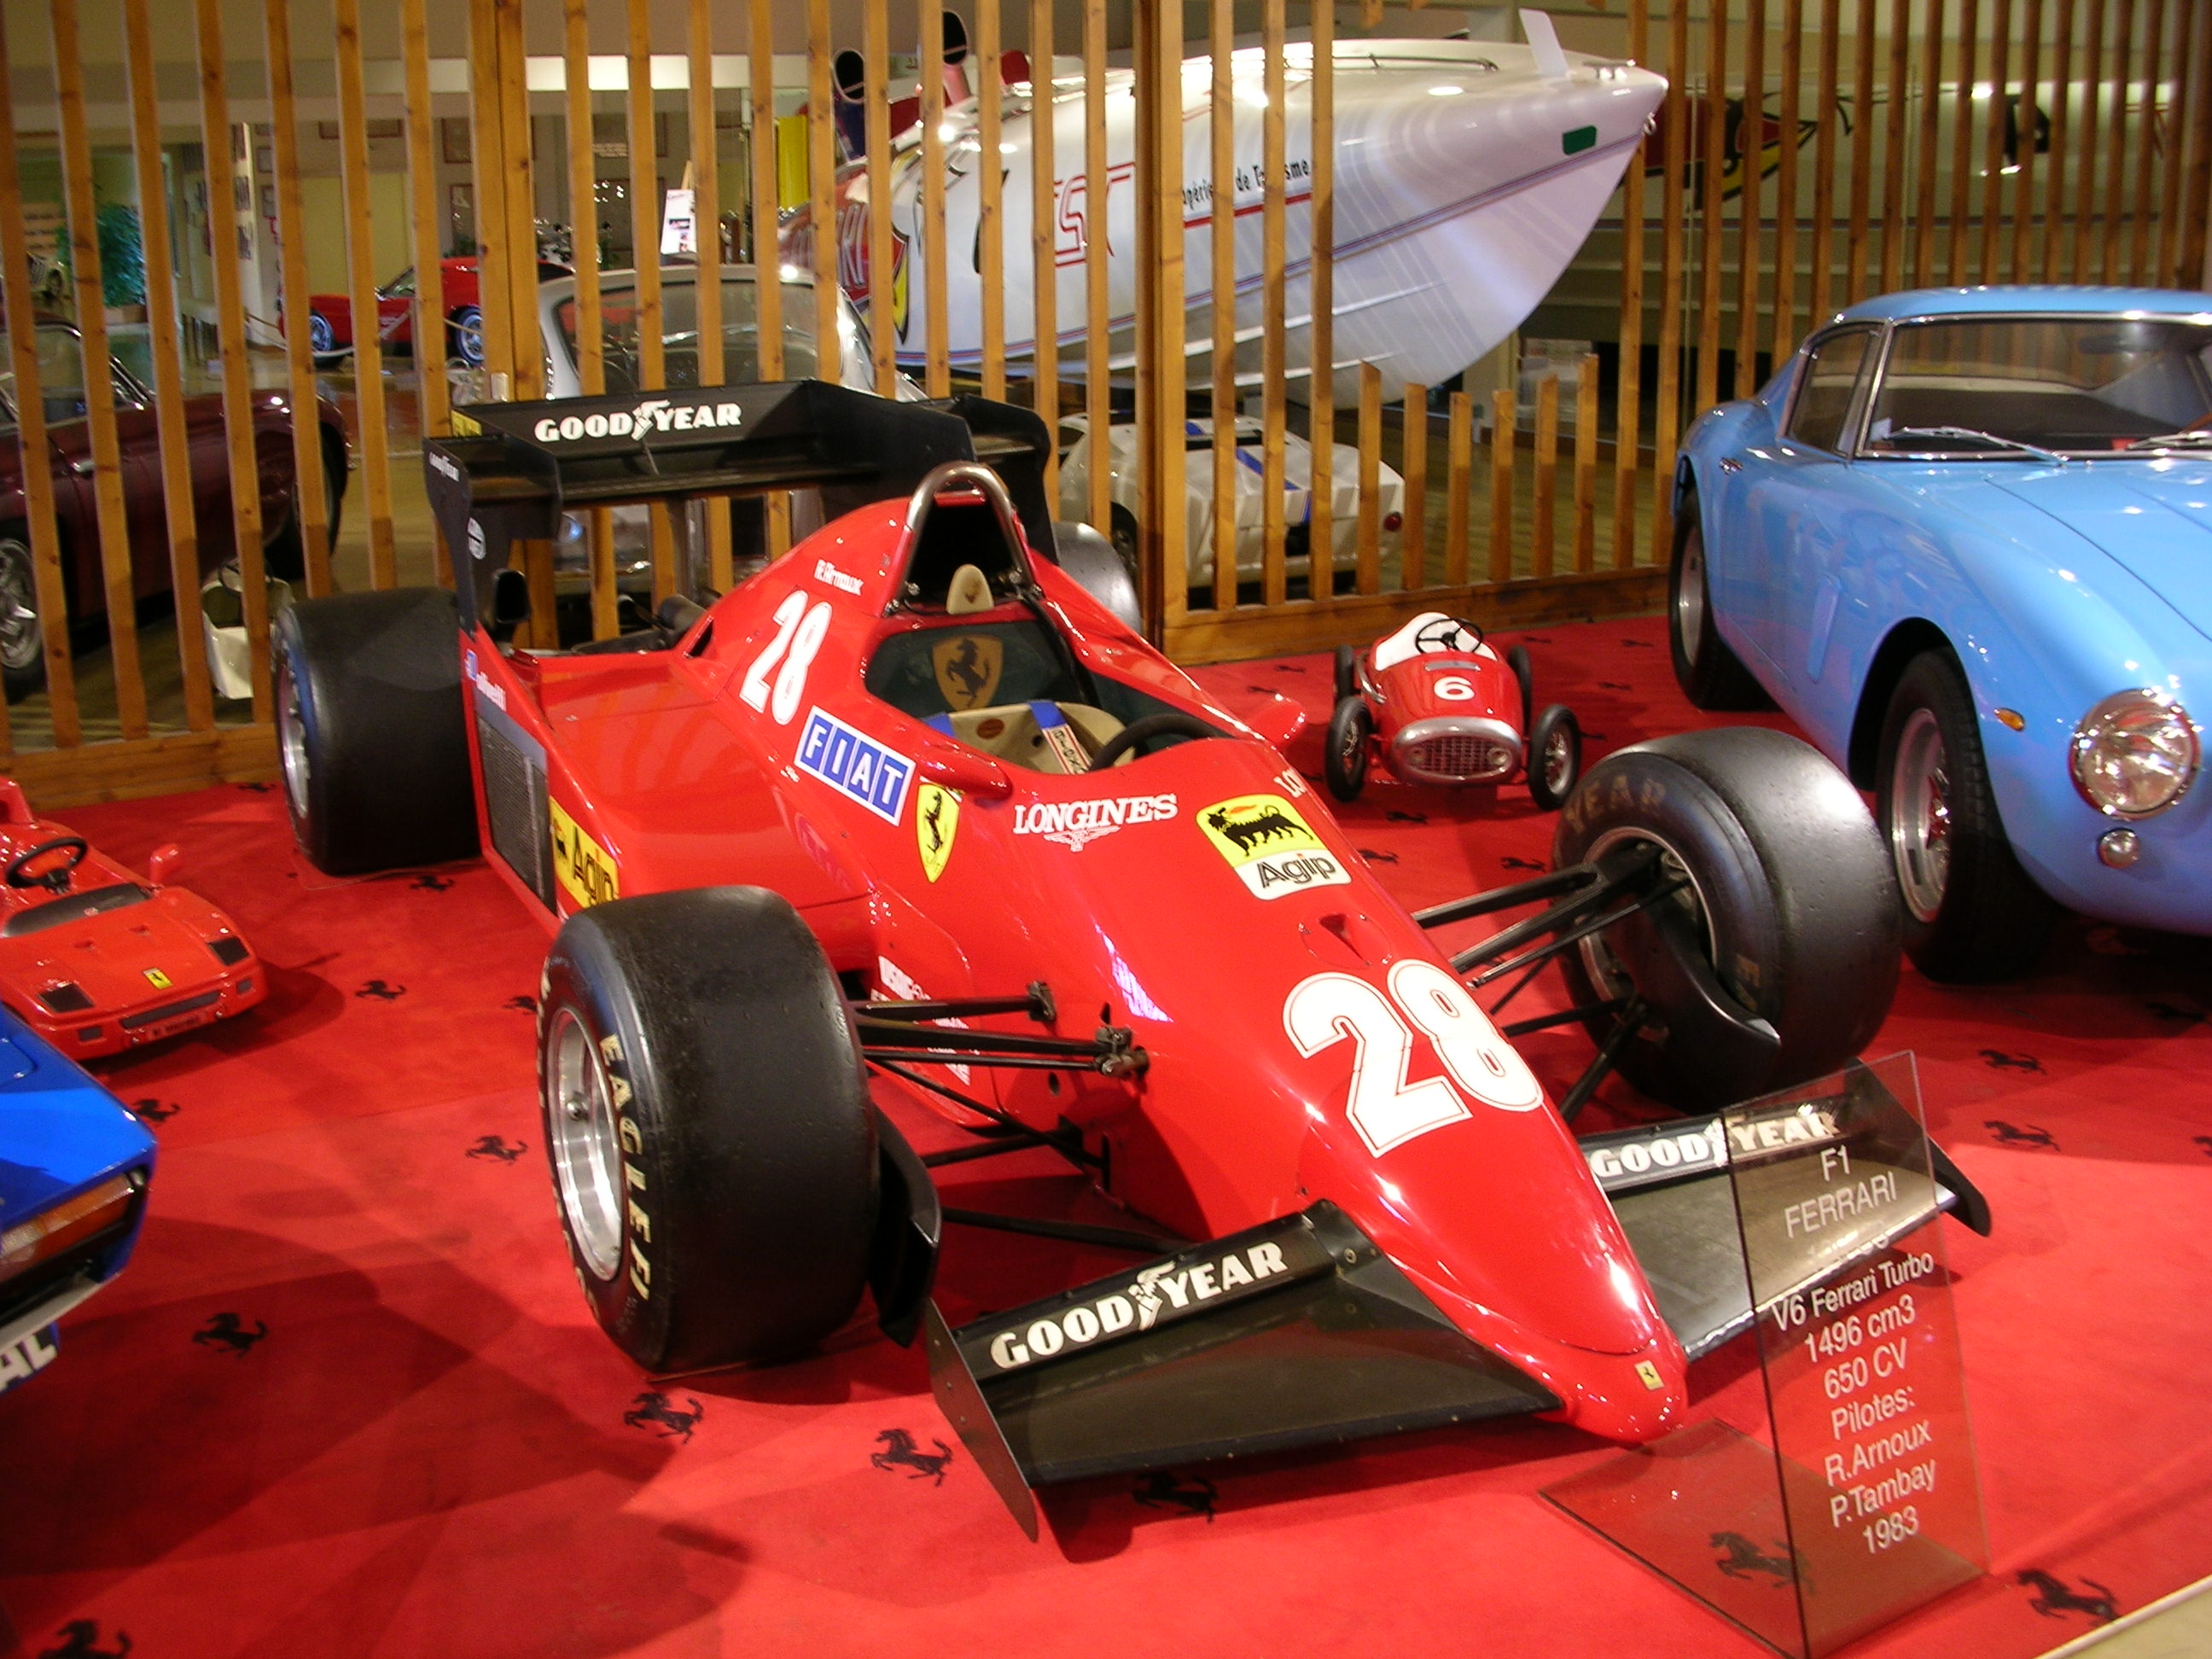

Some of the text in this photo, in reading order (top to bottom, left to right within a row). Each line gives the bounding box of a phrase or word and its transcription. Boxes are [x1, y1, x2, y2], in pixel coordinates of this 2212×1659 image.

[1236, 166, 1250, 192] de
[739, 589, 833, 725] 28
[1433, 675, 1476, 701] 6
[804, 721, 905, 806] FIAT
[1012, 792, 1179, 835] LONGINES
[1257, 853, 1337, 890] Agip
[1282, 958, 1545, 1159] 28
[1819, 1144, 1850, 1182] F1
[1784, 1171, 1898, 1238] FERRARI
[1771, 1252, 1935, 1331] V6 Ferrari Turbo
[1804, 1294, 1916, 1363] 1496 cm3
[1824, 1336, 1907, 1400] 650 CV
[1831, 1385, 1916, 1441] Pilotes:
[1824, 1419, 1932, 1487] R.Arnoux
[1830, 1458, 1936, 1528] P.Tambay
[1863, 1505, 1919, 1554] 1983
